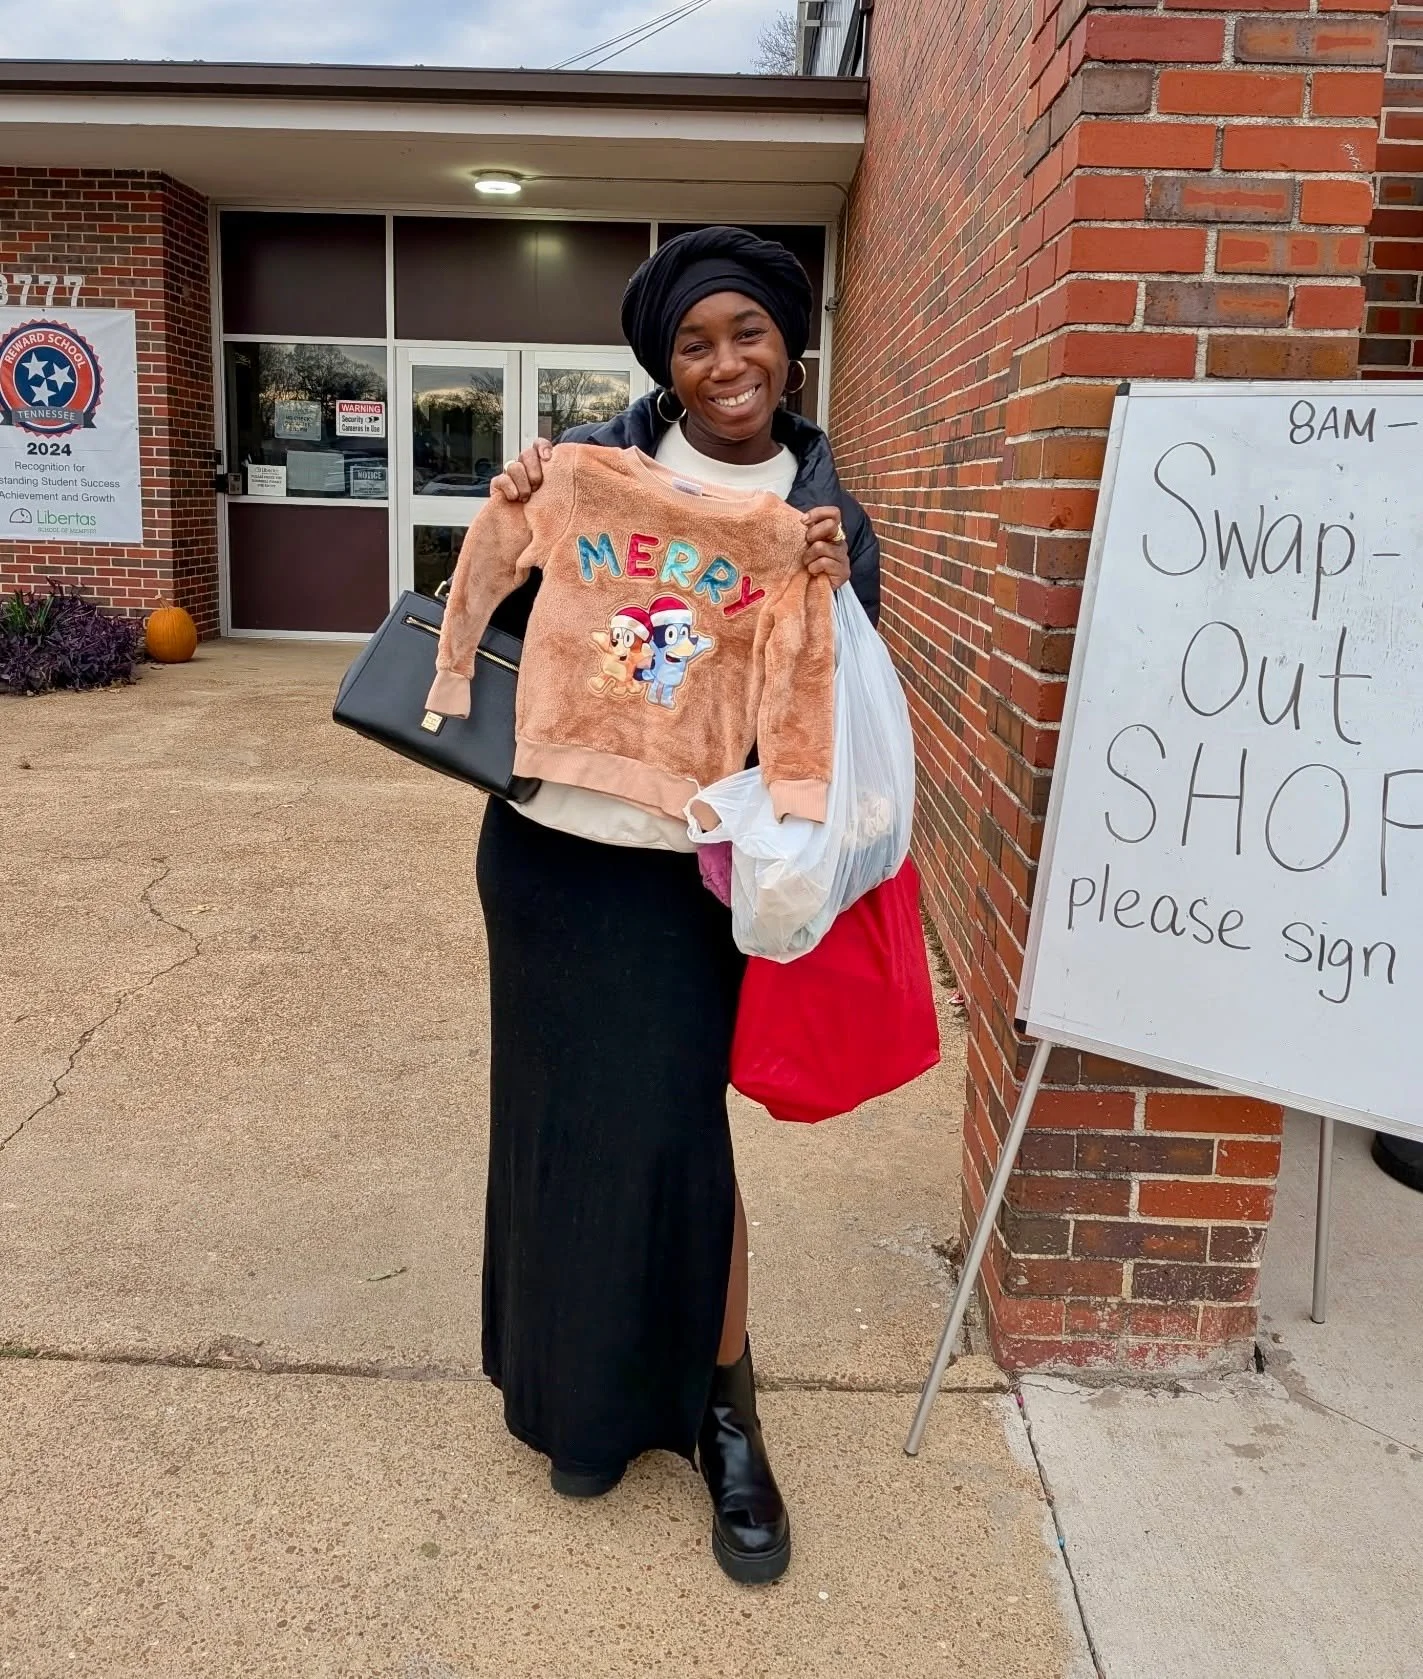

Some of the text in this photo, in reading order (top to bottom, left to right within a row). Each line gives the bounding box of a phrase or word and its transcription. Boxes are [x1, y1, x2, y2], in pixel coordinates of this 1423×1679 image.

[4, 332, 87, 369] REWARD SCHOOL
[341, 403, 381, 413] WARNING
[17, 410, 76, 421] TENNESSEE
[341, 415, 364, 424] Security
[341, 423, 364, 432] Cameras
[26, 442, 73, 456] 2024
[14, 461, 86, 473] Recognition for
[357, 471, 382, 480] NOTICE
[41, 477, 77, 487] Student
[80, 478, 121, 488] Success
[0, 491, 116, 503] Achievement and Growth
[37, 509, 97, 526] Libertas
[576, 532, 766, 619] MERRY
[1181, 621, 1371, 744] Out
[1282, 921, 1396, 1004] sign
